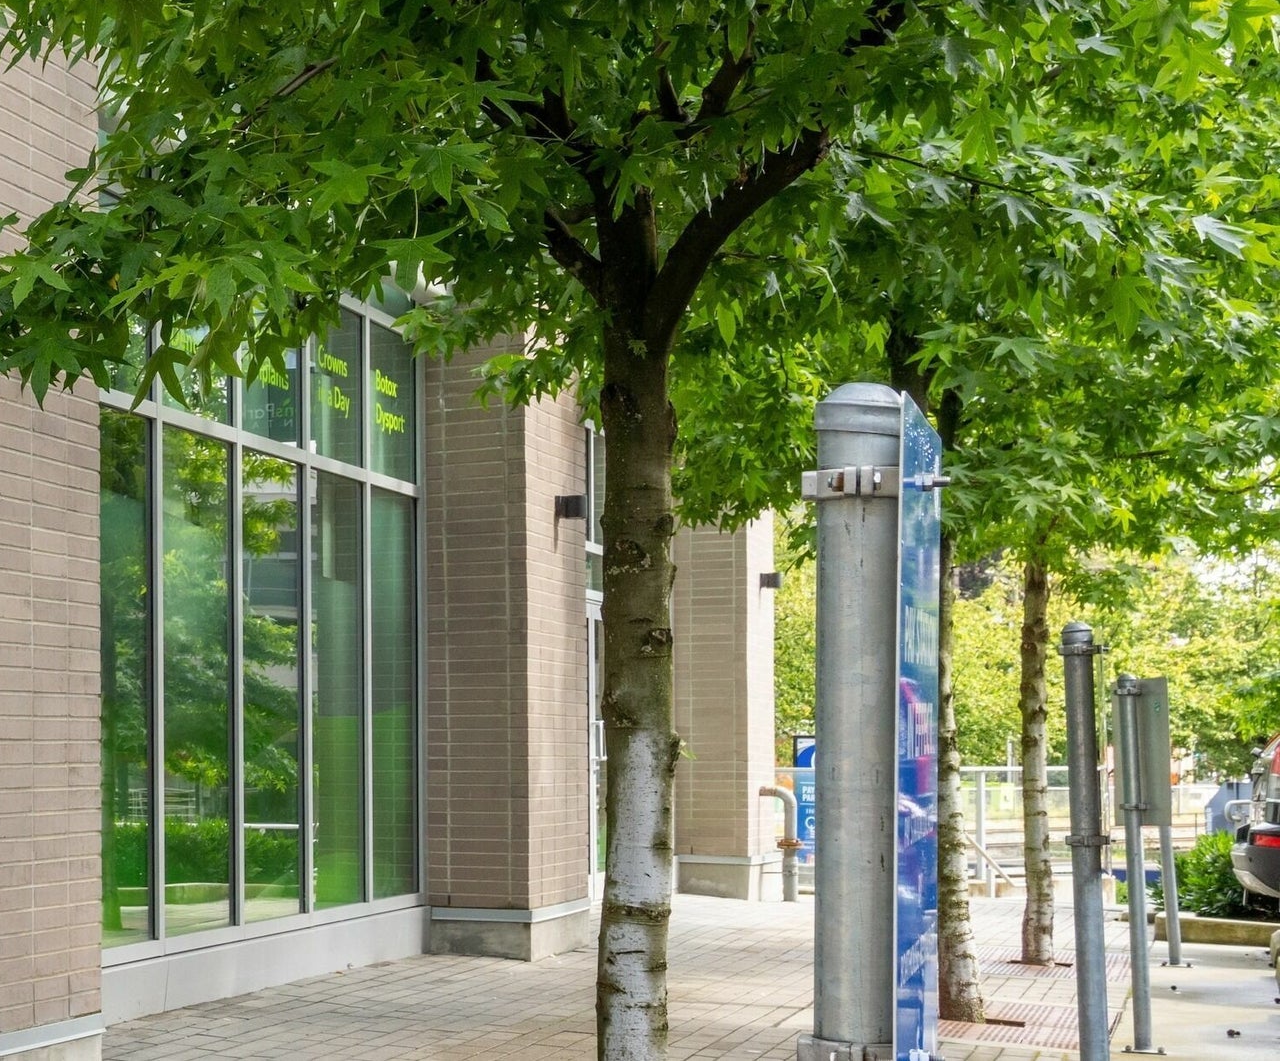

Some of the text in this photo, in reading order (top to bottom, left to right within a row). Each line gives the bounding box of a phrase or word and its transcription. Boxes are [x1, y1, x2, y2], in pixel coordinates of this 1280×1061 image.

[317, 344, 348, 377] Crowns
[375, 368, 398, 398] Botox
[334, 386, 350, 419] Day
[375, 403, 405, 435] Dysport
[802, 794, 815, 802] PAR
